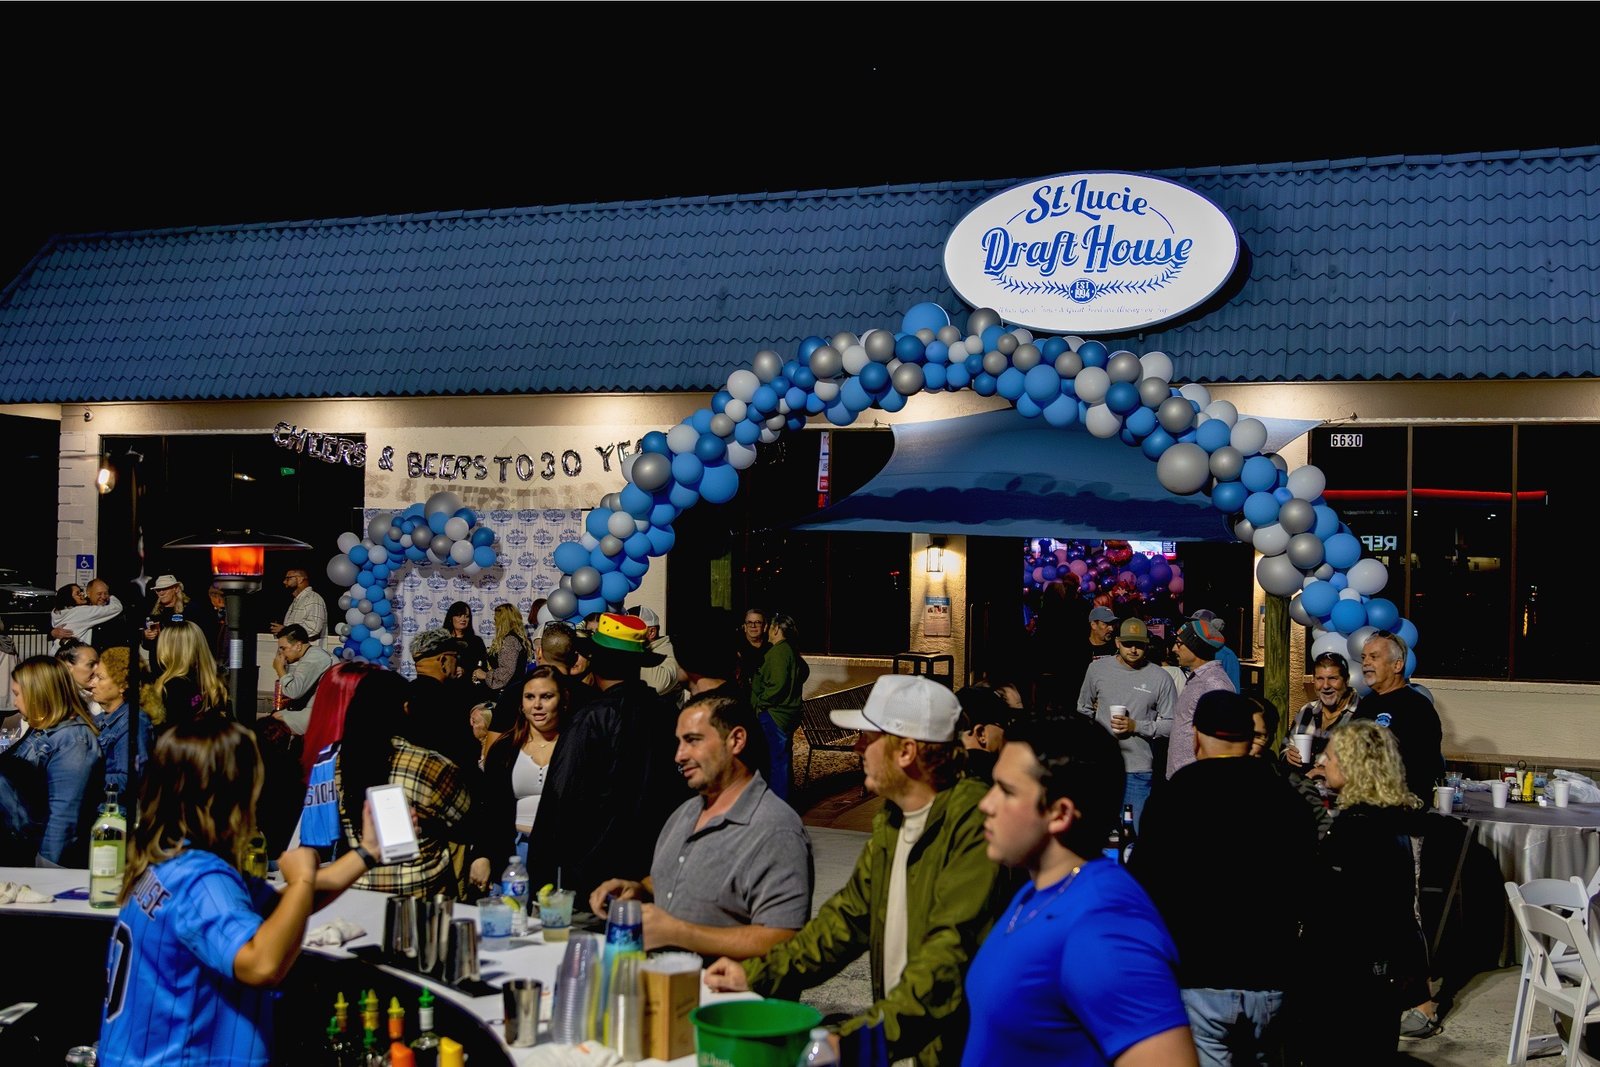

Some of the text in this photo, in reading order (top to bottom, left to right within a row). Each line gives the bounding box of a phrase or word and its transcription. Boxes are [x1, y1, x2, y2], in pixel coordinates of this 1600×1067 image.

[1025, 179, 1148, 224] St. Lucie
[981, 224, 1194, 277] Draft House
[1076, 281, 1090, 290] EST
[272, 421, 368, 467] CHEERS
[378, 445, 395, 471] &
[407, 451, 488, 482] BEERS
[594, 438, 643, 473] YE
[1331, 434, 1362, 447] 6630
